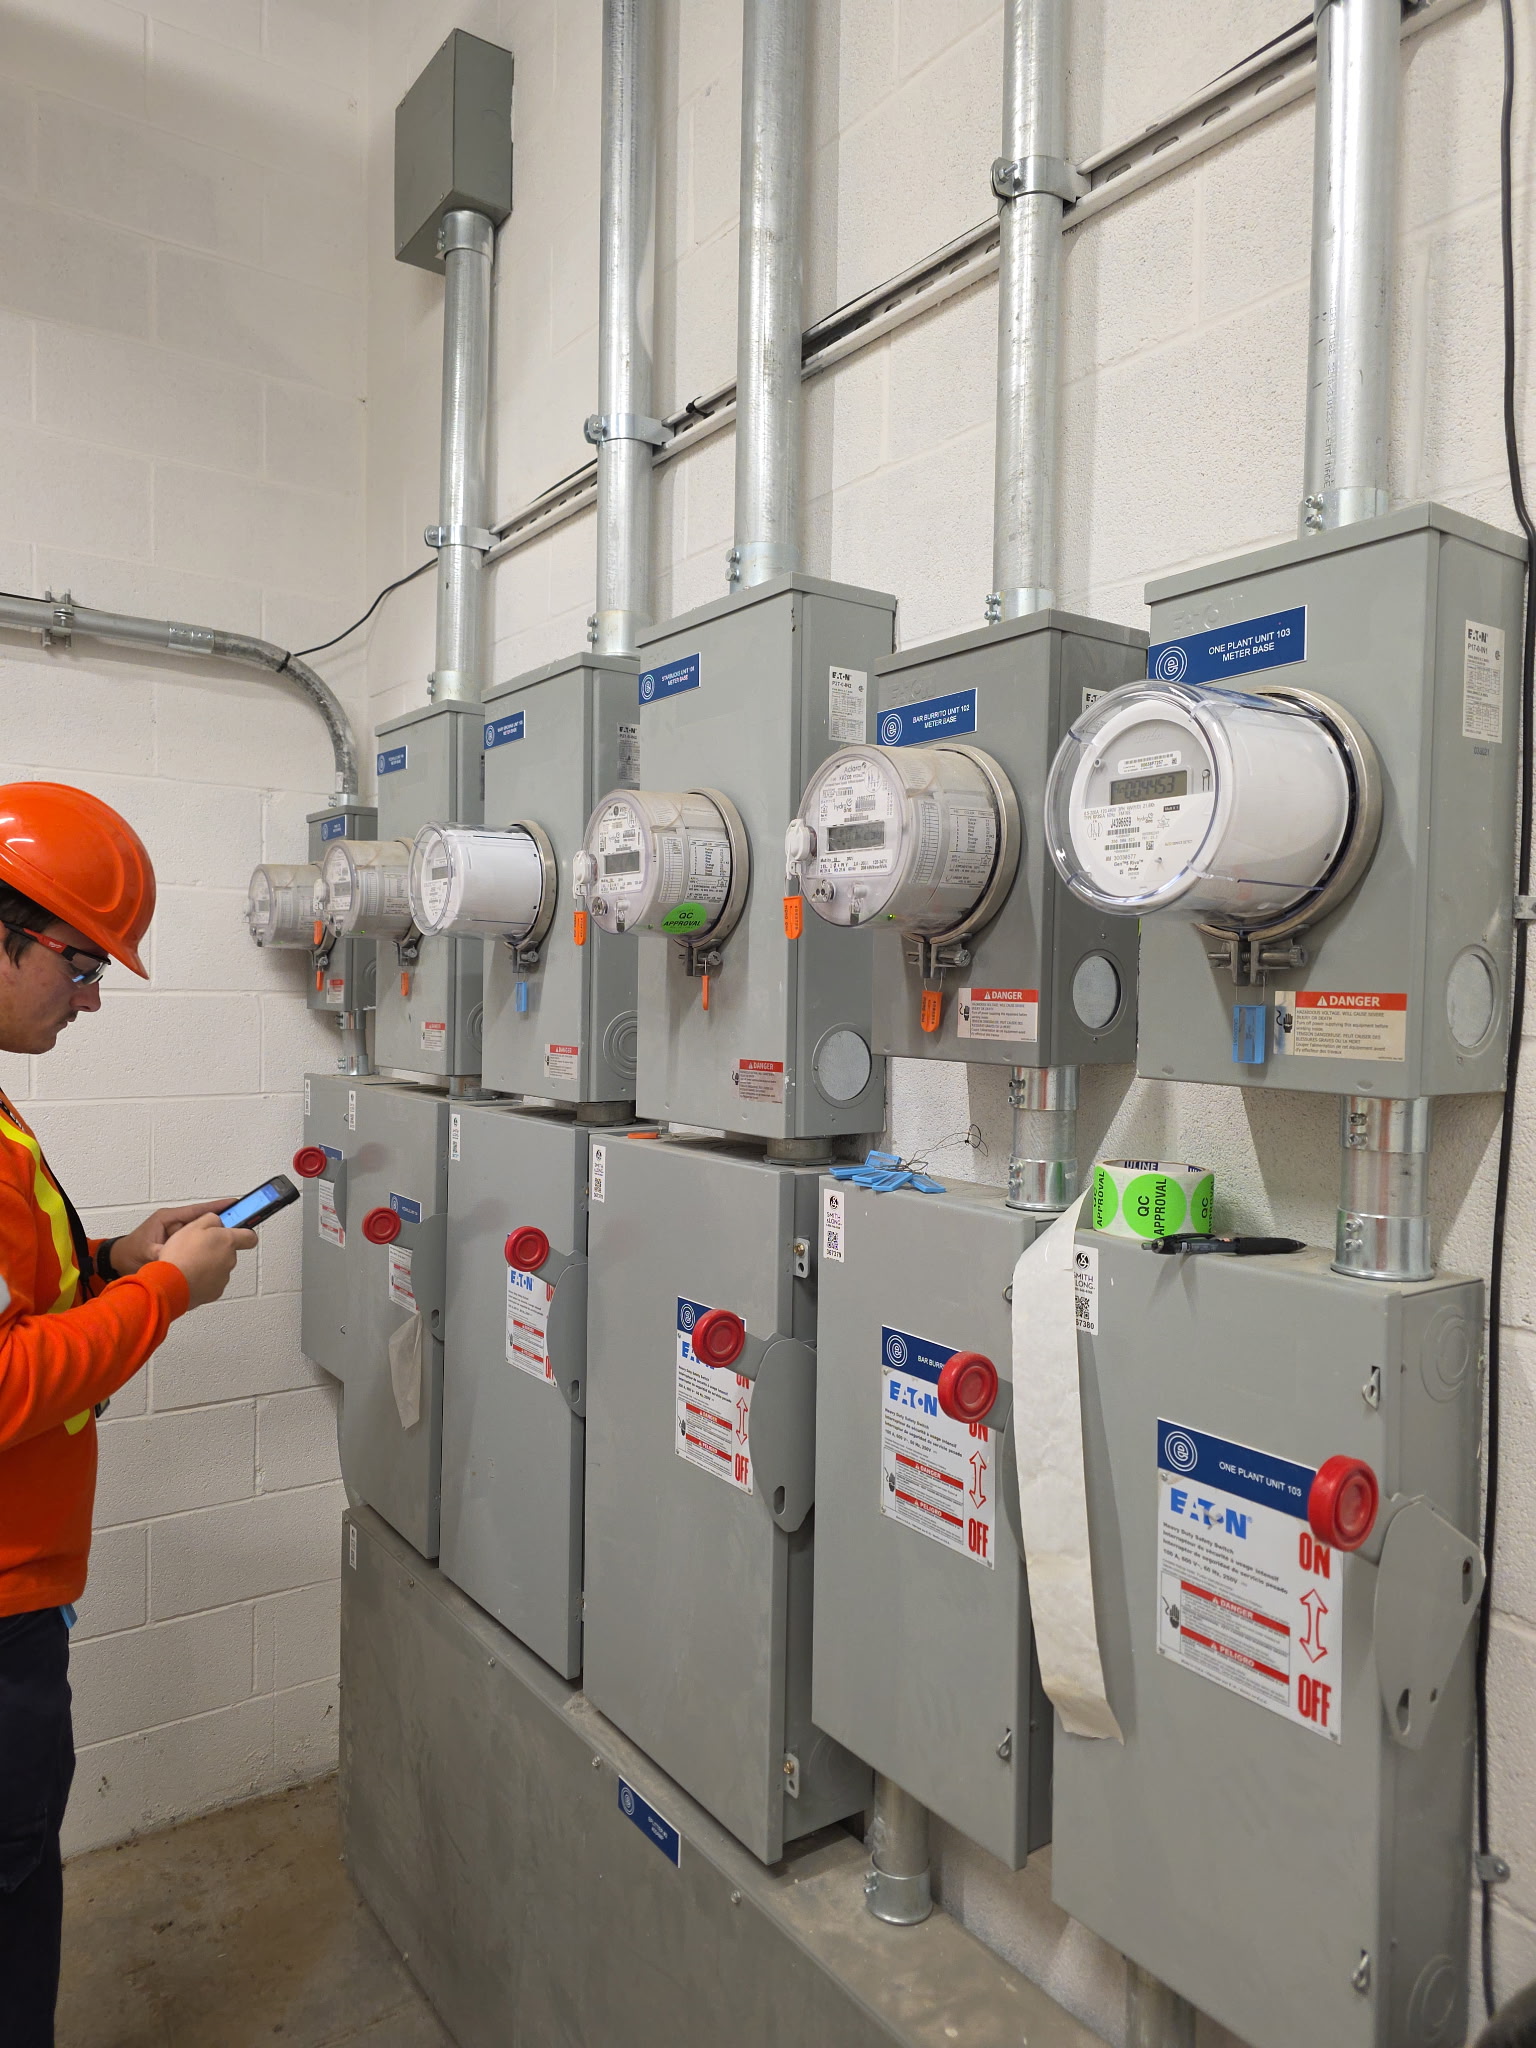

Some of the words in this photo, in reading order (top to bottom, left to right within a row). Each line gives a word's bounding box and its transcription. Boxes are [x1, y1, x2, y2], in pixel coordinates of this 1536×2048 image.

[1208, 644, 1226, 655] ONE
[1227, 637, 1254, 650] PLANT
[1254, 632, 1275, 643] UNIT
[1276, 627, 1291, 639] 103
[1222, 648, 1250, 662] METER
[1252, 642, 1275, 654] BASE
[913, 715, 923, 723] BAR
[924, 709, 947, 721] BURRITO
[948, 707, 960, 715] UNIT
[924, 718, 942, 729] METER
[991, 991, 1023, 1000] DANGER
[1329, 995, 1380, 1007] DANGER
[753, 1062, 774, 1070] DANGER
[1126, 1161, 1157, 1171] ULINE
[1137, 1196, 1149, 1217] QC
[1153, 1179, 1167, 1236] APPROVAL
[1202, 1197, 1208, 1218] QC
[917, 1355, 929, 1365] BAR
[889, 1379, 938, 1417] EATON
[735, 1453, 749, 1485] OFF
[1219, 1461, 1237, 1475] ONE
[1237, 1466, 1265, 1485] PLANT
[1265, 1476, 1286, 1491] UNIT
[1287, 1484, 1302, 1497] 103
[920, 1501, 942, 1517] PELIGRO
[1170, 1487, 1247, 1540] EATON
[968, 1517, 989, 1558] OFF
[1299, 1532, 1330, 1579] ON
[1220, 1599, 1254, 1620] DANGER
[1220, 1645, 1255, 1667] PELIGRO
[1297, 1673, 1332, 1727] OFF
